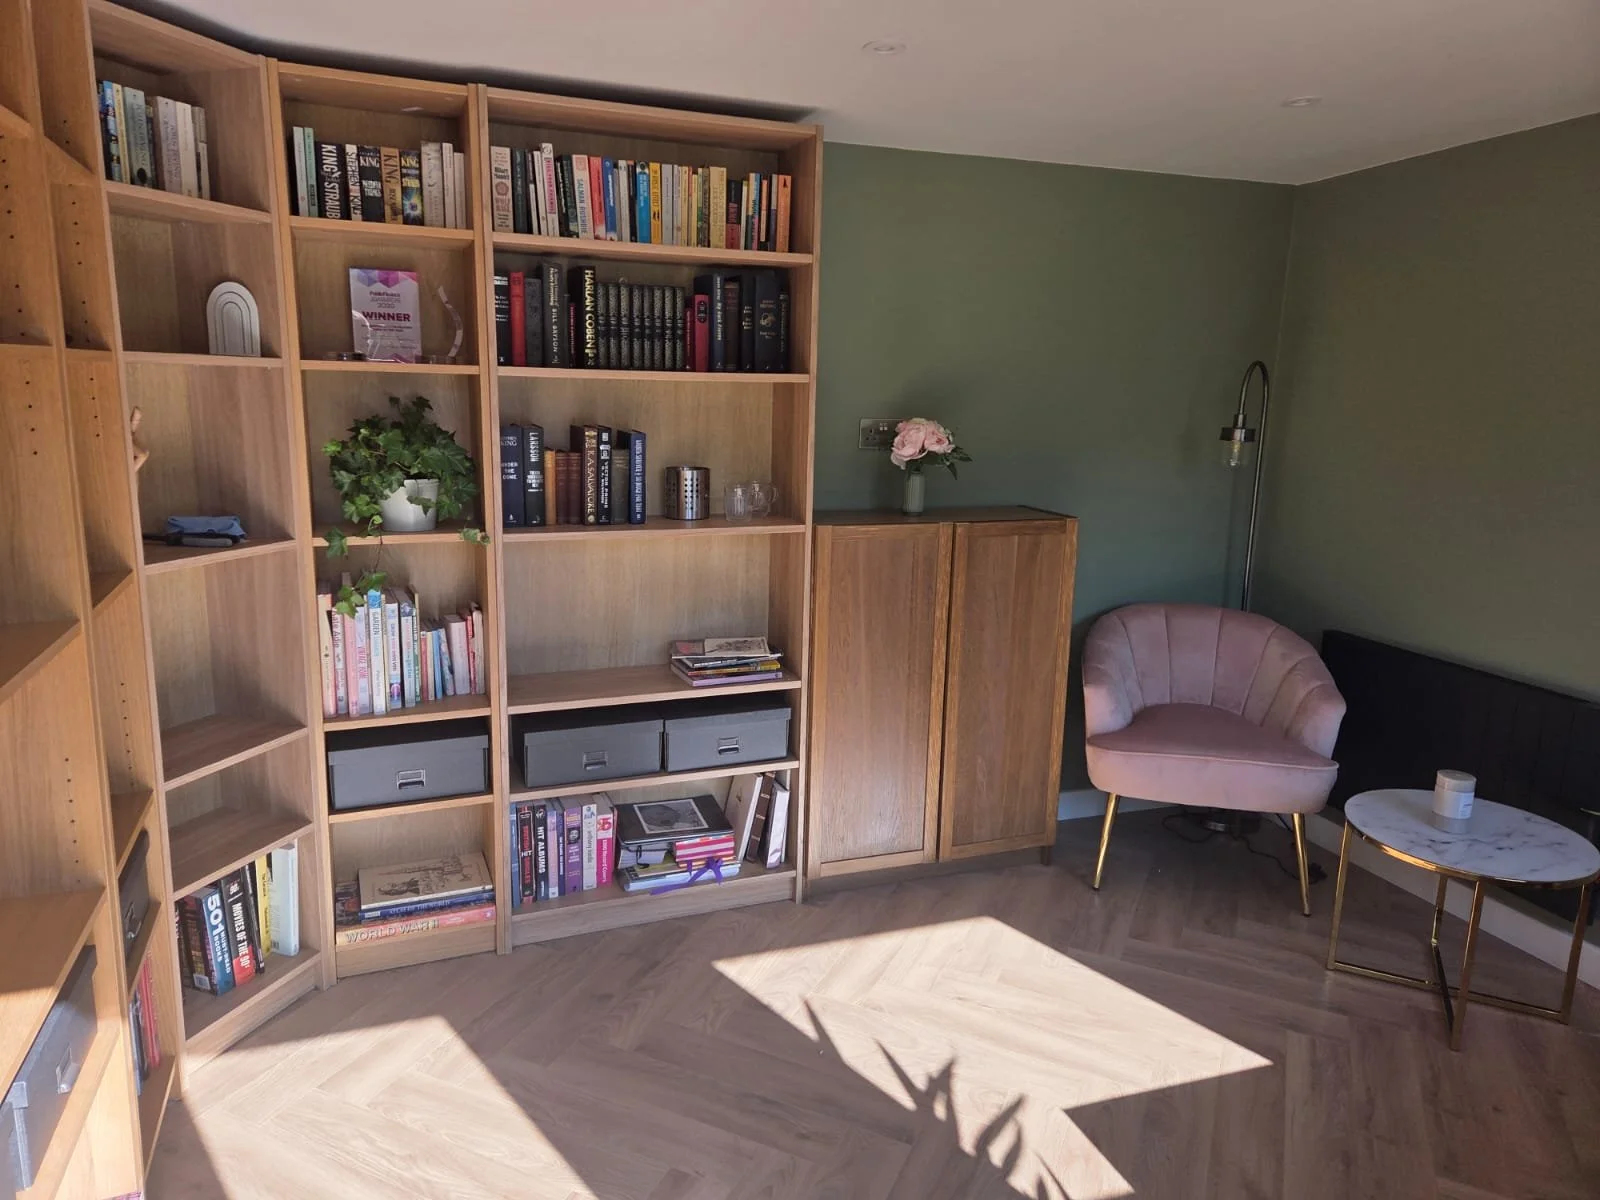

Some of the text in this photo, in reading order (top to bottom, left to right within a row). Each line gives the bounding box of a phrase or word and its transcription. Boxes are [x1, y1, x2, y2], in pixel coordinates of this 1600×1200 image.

[320, 144, 338, 173] KING
[360, 156, 380, 168] KING
[384, 154, 399, 186] KING
[401, 156, 419, 168] KING
[324, 181, 341, 220] STRAUB
[577, 178, 586, 204] SALMAN
[350, 195, 362, 218] KING
[362, 311, 411, 322] WINNER
[584, 269, 595, 348] HARLAN COBEN
[529, 432, 540, 462] LARSSON
[372, 612, 380, 635] GARDEN
[538, 842, 546, 874] ALBUMS
[207, 893, 225, 936] 501
[232, 902, 246, 932] MOVIES
[236, 932, 246, 942] OF
[346, 926, 396, 943] WORLD
[400, 922, 429, 934] WAR
[430, 918, 440, 928] II
[214, 936, 223, 962] BOOKS
[238, 942, 249, 956] THE
